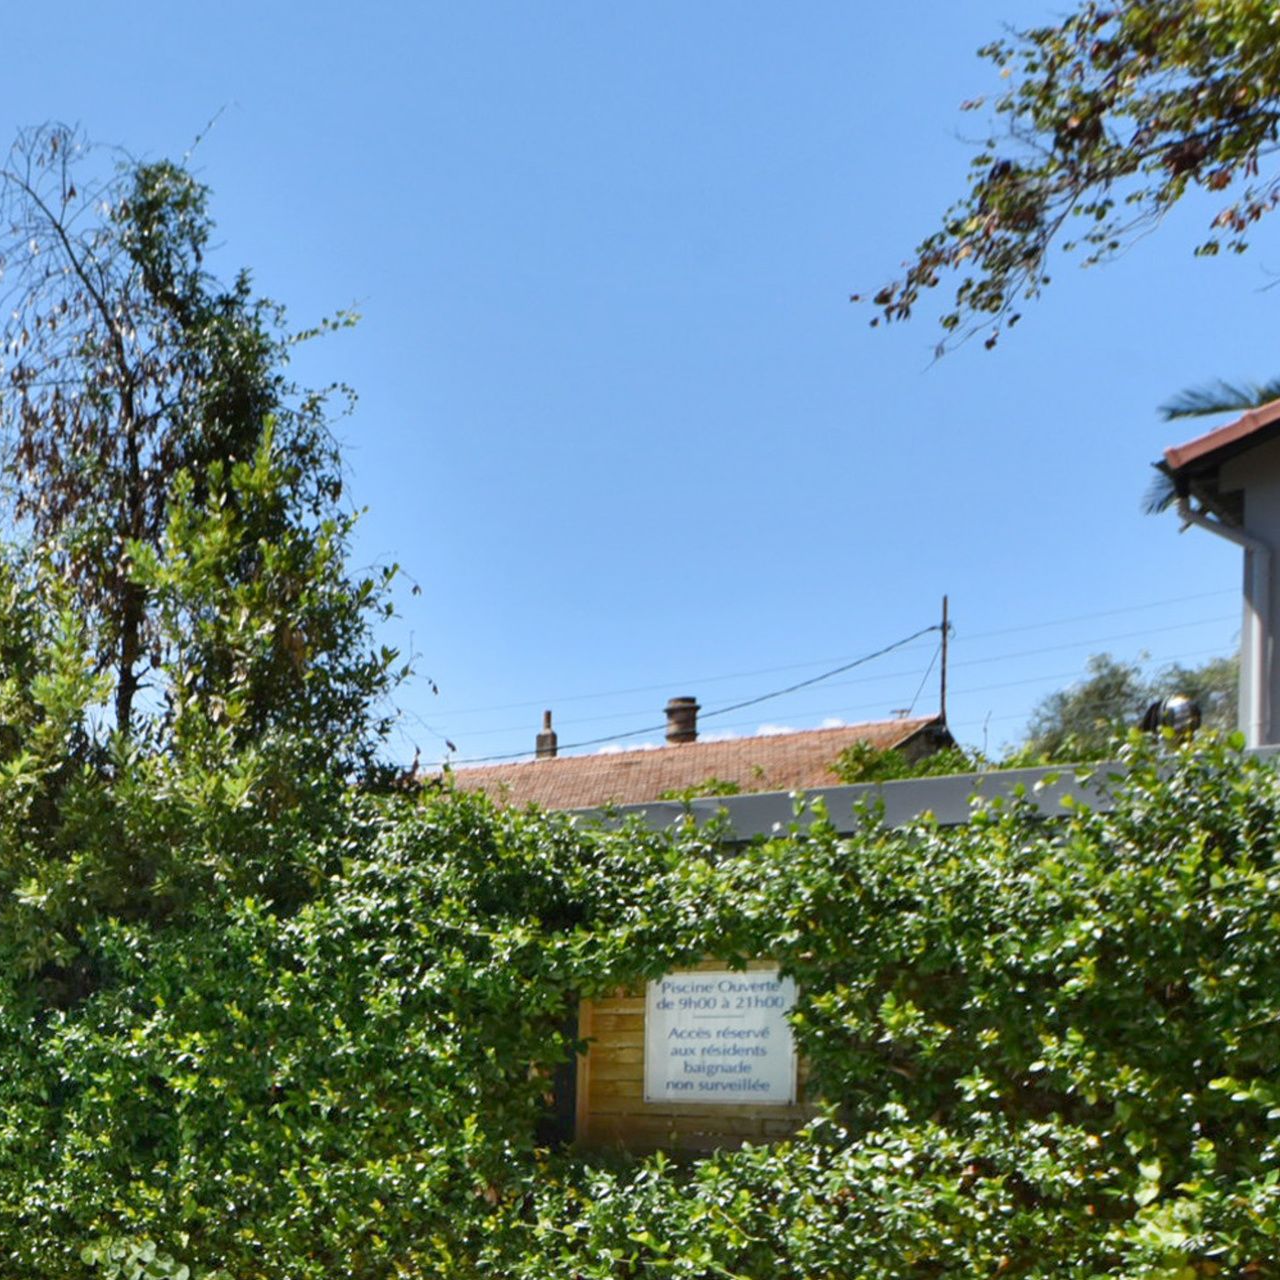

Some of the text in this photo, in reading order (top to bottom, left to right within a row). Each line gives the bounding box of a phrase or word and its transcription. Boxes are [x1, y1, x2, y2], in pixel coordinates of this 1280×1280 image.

[661, 980, 780, 994] Piscine Ouverte
[656, 997, 784, 1010] de 9h00 à 21h00
[668, 1026, 770, 1039] Accès réservé
[670, 1043, 768, 1057] aux résidents
[683, 1060, 752, 1077] baignade
[666, 1079, 770, 1092] non surveillée
